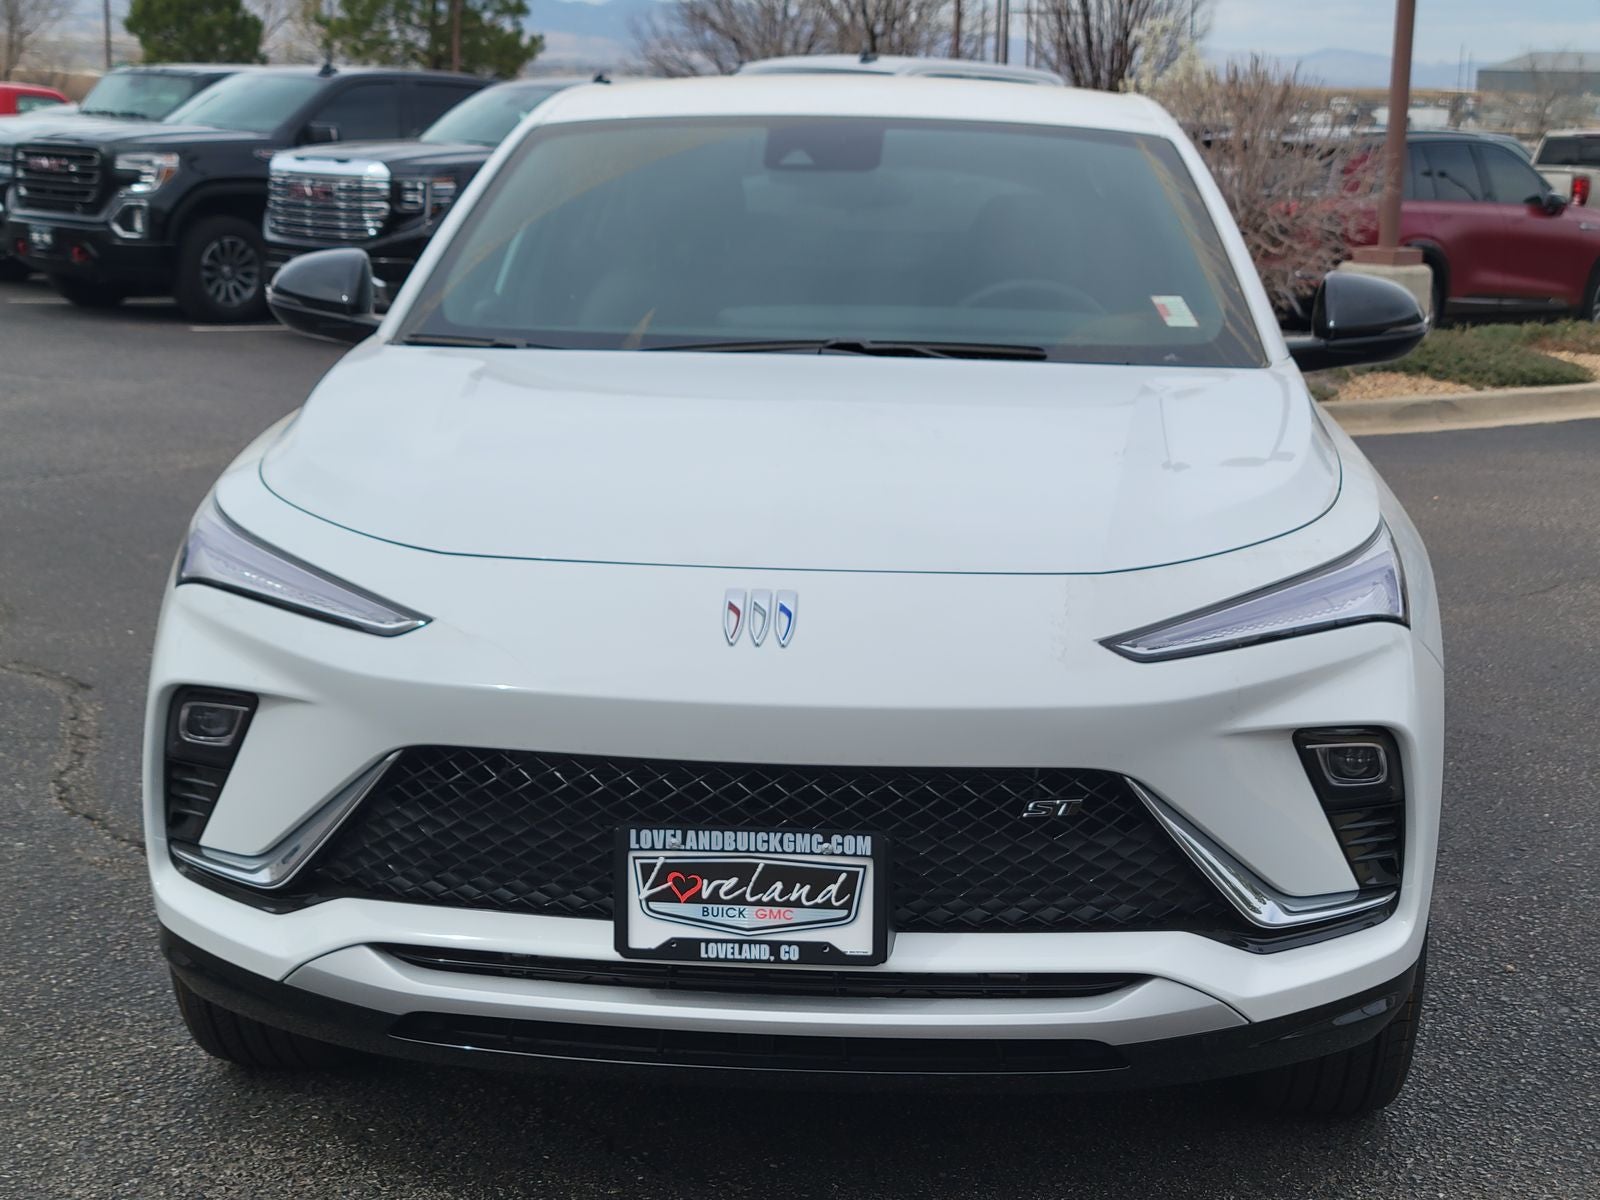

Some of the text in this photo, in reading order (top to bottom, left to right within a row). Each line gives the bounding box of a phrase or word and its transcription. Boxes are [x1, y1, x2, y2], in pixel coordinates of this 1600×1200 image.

[1022, 799, 1083, 817] ST
[629, 828, 872, 856] LOVELANDBUICKGMCCOM
[701, 906, 794, 921] BUICK GMC
[700, 942, 800, 962] LOVELAND, CO
